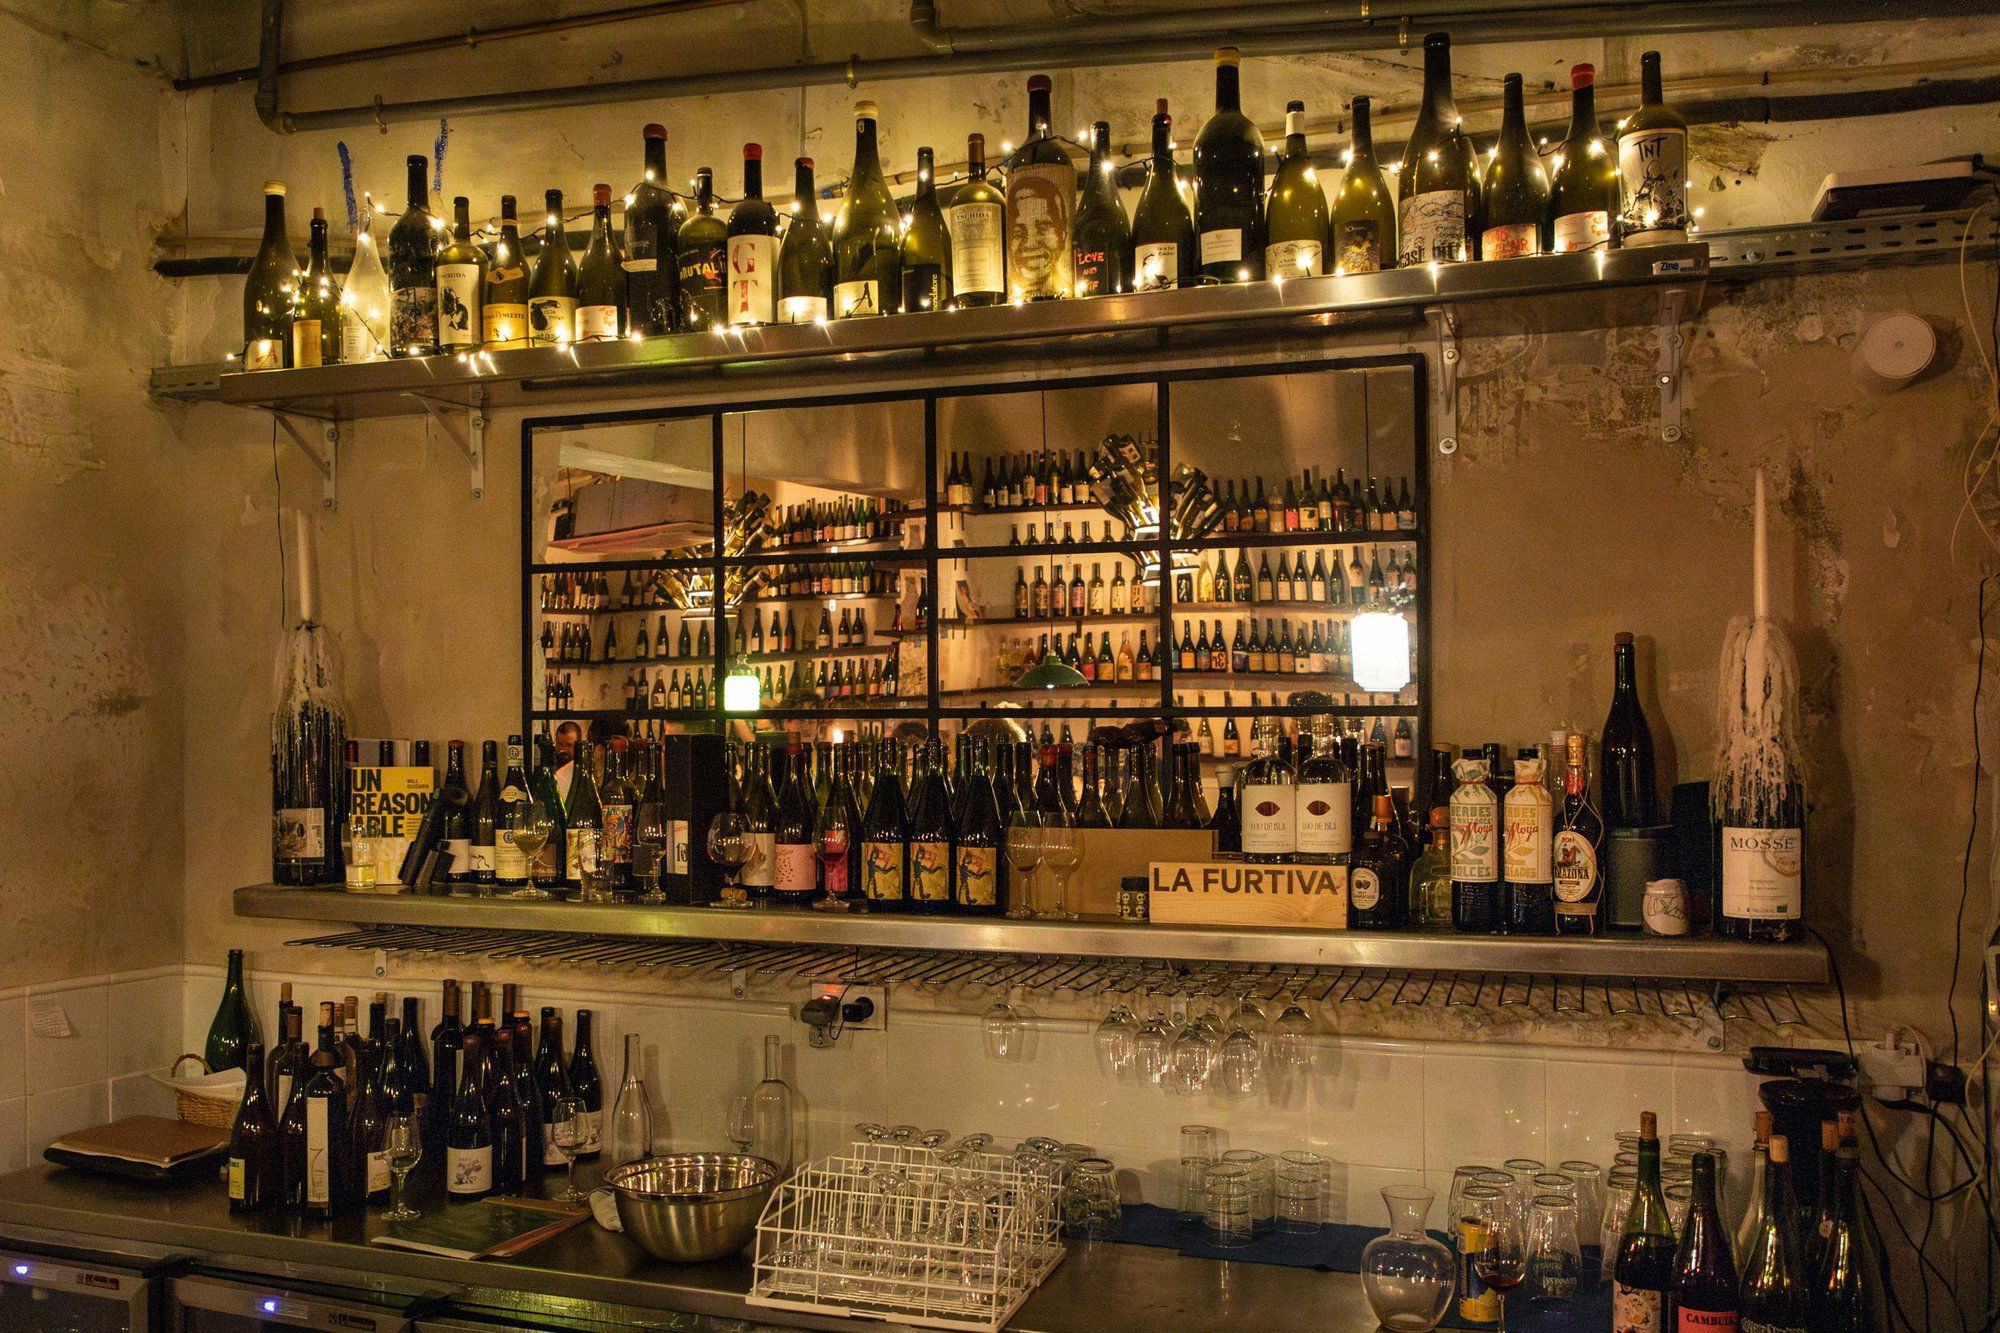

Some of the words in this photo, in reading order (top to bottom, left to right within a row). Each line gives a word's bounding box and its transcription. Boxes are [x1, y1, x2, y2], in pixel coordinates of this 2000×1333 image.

[1633, 136, 1667, 162] TNT
[732, 242, 757, 274] G
[1076, 251, 1105, 266] LOVE
[732, 279, 758, 313] T
[352, 768, 382, 792] UN
[352, 792, 434, 816] REASON
[351, 815, 405, 838] ABLE
[1730, 836, 1795, 850] MOSSE
[1153, 867, 1194, 893] LA
[1202, 868, 1339, 896] FURTIVA
